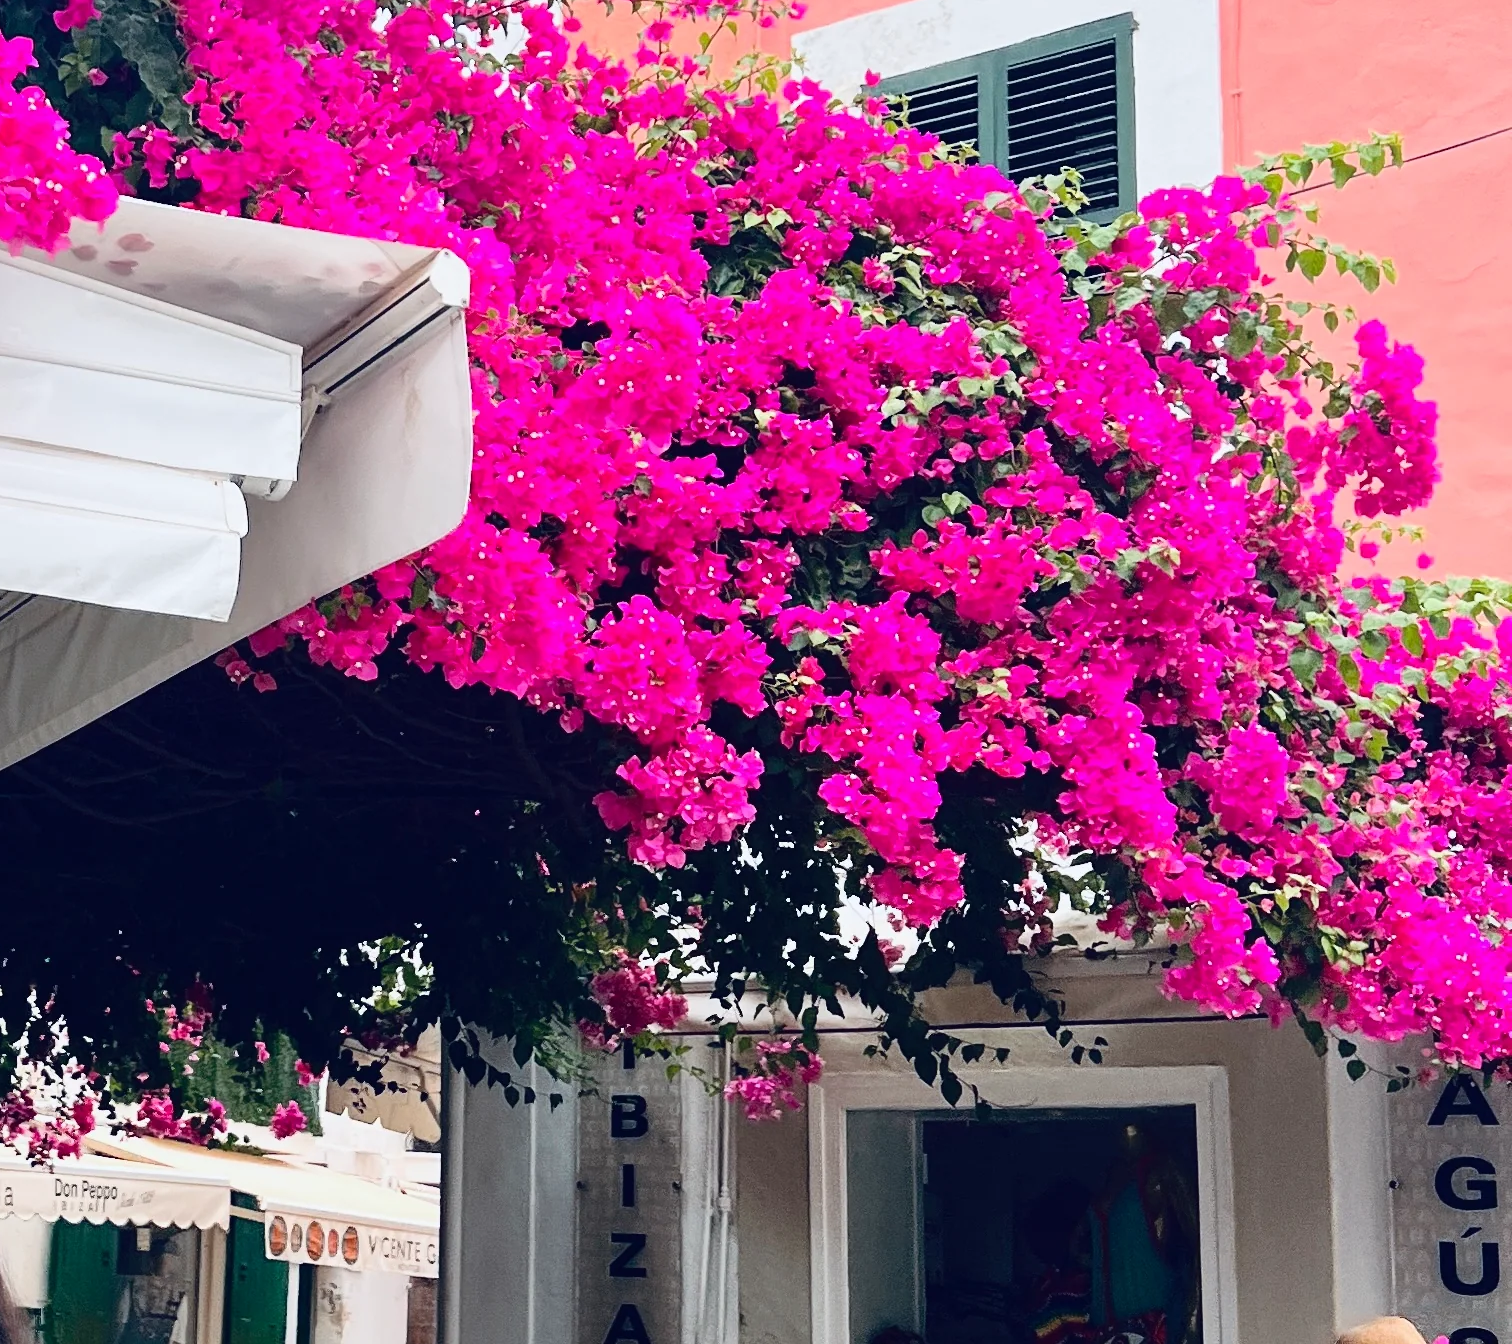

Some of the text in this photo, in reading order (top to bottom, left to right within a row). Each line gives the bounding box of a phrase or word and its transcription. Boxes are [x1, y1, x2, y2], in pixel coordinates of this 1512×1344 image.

[54, 1177, 78, 1198] Don
[81, 1179, 119, 1213] Peppo
[368, 1234, 422, 1263] VCENTE
